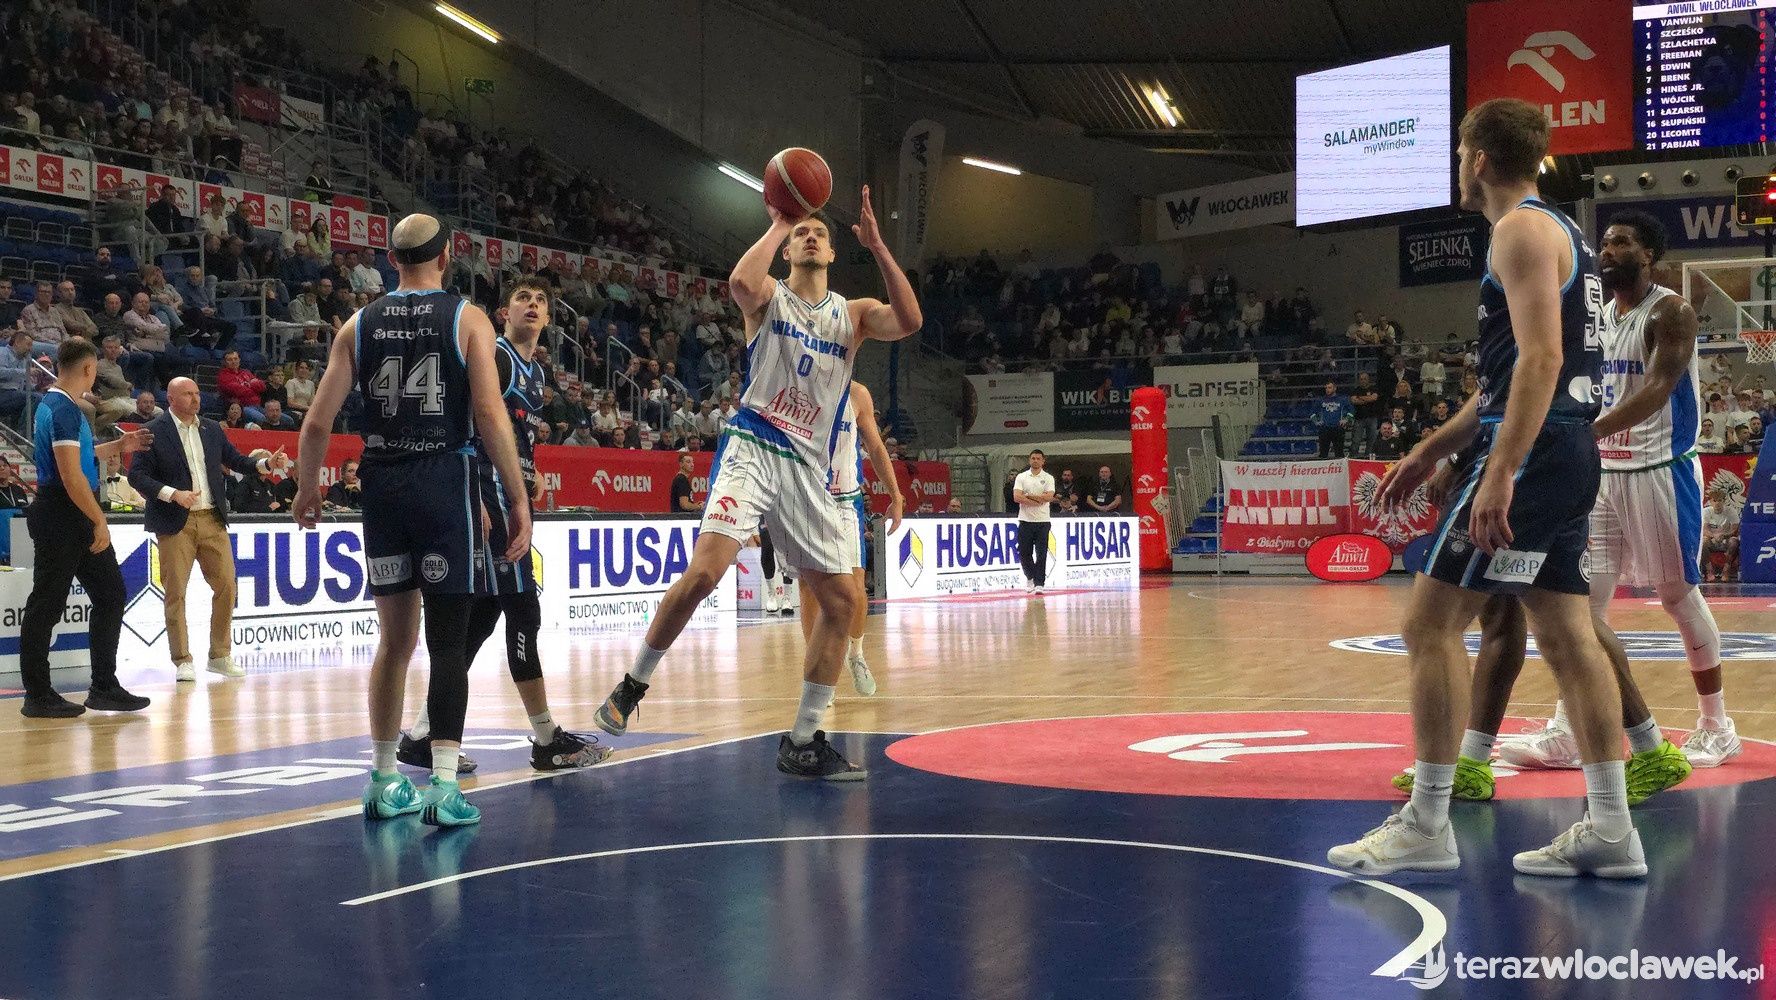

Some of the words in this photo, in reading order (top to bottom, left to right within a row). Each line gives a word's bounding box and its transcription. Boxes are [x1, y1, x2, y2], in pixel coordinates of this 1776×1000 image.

[1667, 4, 1696, 15] ANWIL
[1700, 0, 1758, 12] WŁOCŁAWEK
[1660, 16, 1703, 27] VANWIJN
[1660, 27, 1704, 38] SZCZEŚKO
[1660, 38, 1716, 49] SZLACHETKA
[1646, 54, 1652, 62] 5
[1660, 50, 1702, 60] FREEMAN
[1660, 62, 1691, 72] EDWIN
[1660, 73, 1690, 82] BRENK
[1660, 84, 1688, 94] HINES
[1660, 94, 1696, 105] WÓJCIK
[1543, 99, 1606, 128] LEN
[1660, 105, 1704, 116] ŁAZARSKI
[1660, 116, 1706, 127] SŁUPIŃSKI
[1324, 118, 1415, 148] SALAMANDER
[1660, 128, 1702, 138] LECOMTE
[1364, 137, 1415, 156] myWindow
[1660, 140, 1700, 150] PABIJAN
[1208, 190, 1289, 216] WŁOCŁAWEK
[1409, 236, 1474, 264] SELENKA
[1412, 260, 1445, 273] WIENIEC
[382, 304, 434, 317] JUSICE
[797, 354, 814, 378] 0
[368, 352, 446, 418] 44
[1604, 385, 1614, 407] 5
[764, 388, 821, 426] Anwil
[787, 425, 812, 438] ORLEN
[1234, 465, 1248, 476] W
[1252, 464, 1287, 478] naszej
[1290, 463, 1343, 476] hierarchii
[613, 474, 652, 492] ORLEN
[1226, 488, 1337, 526] ANWIL
[708, 513, 738, 526] ORLEN
[936, 522, 1020, 569] HUSAR
[1066, 522, 1131, 561] HUSAR
[1256, 536, 1296, 552] Białym
[568, 526, 701, 590] HUSA
[1328, 544, 1370, 563] Anwil
[233, 530, 379, 608] HUS
[569, 600, 649, 619] BUDOWNICTWO
[233, 620, 344, 646] UDOWNICTWO
